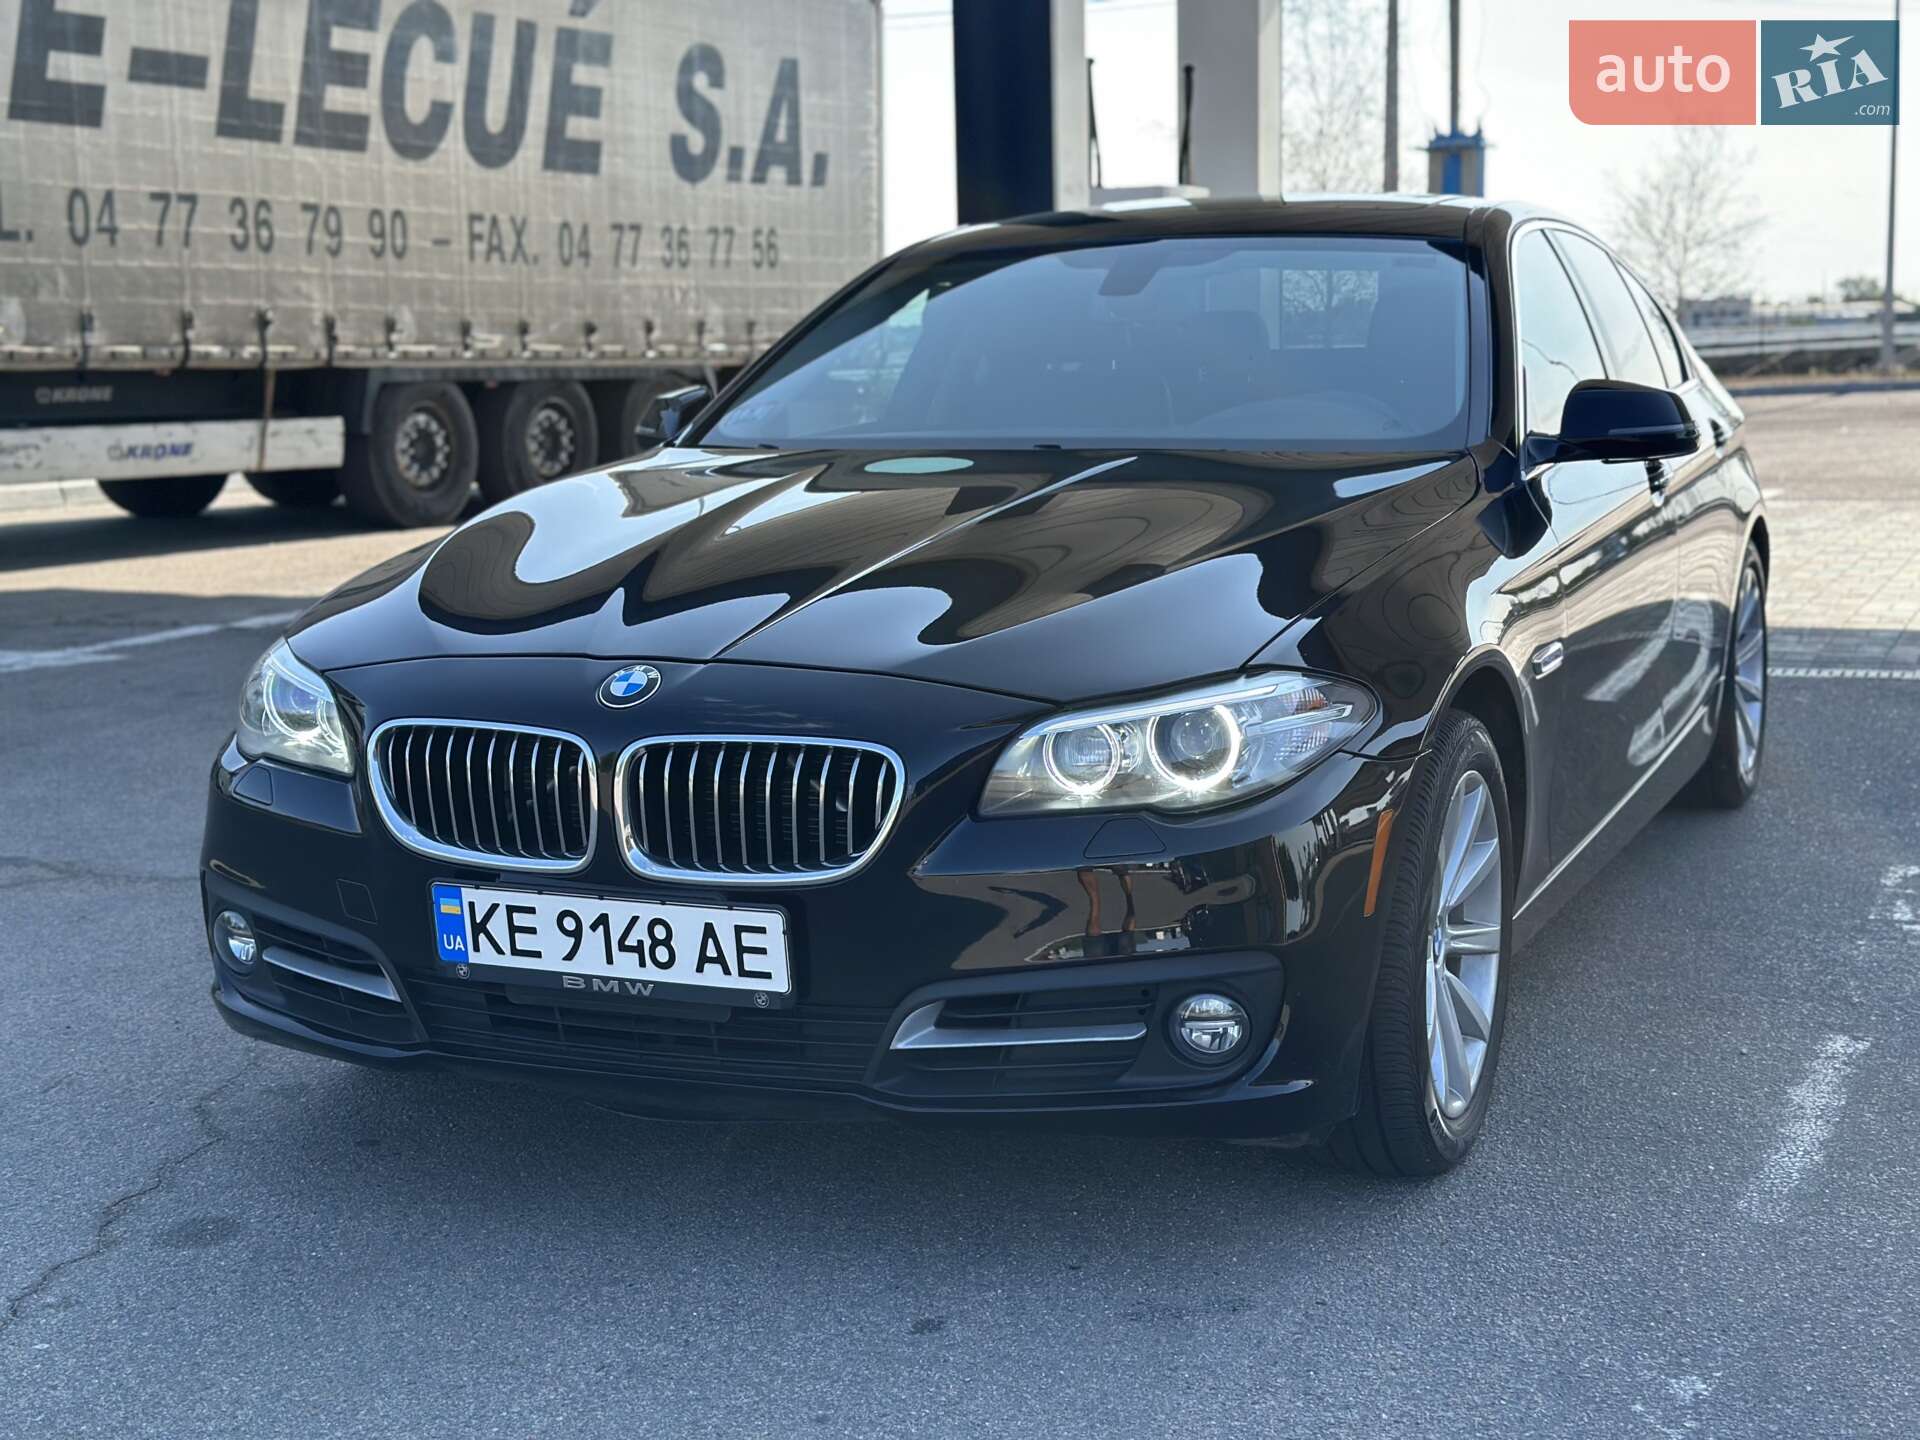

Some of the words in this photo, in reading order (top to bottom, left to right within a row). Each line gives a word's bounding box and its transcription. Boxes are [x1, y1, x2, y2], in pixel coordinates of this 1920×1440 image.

[669, 42, 829, 187] S.A.
[67, 188, 119, 246] 04
[149, 193, 198, 247] 77
[229, 198, 274, 252] 36
[300, 203, 342, 257] 79
[367, 208, 408, 260] 90
[468, 213, 539, 266] FAX.
[558, 221, 591, 267] 04
[610, 223, 642, 267] 77
[661, 226, 690, 268] 36
[706, 227, 735, 269] 77
[752, 228, 778, 269] 56
[443, 933, 465, 952] UA
[468, 901, 542, 959] KE
[556, 909, 676, 970] 9148
[695, 922, 772, 980] AE
[563, 975, 655, 996] BMW
